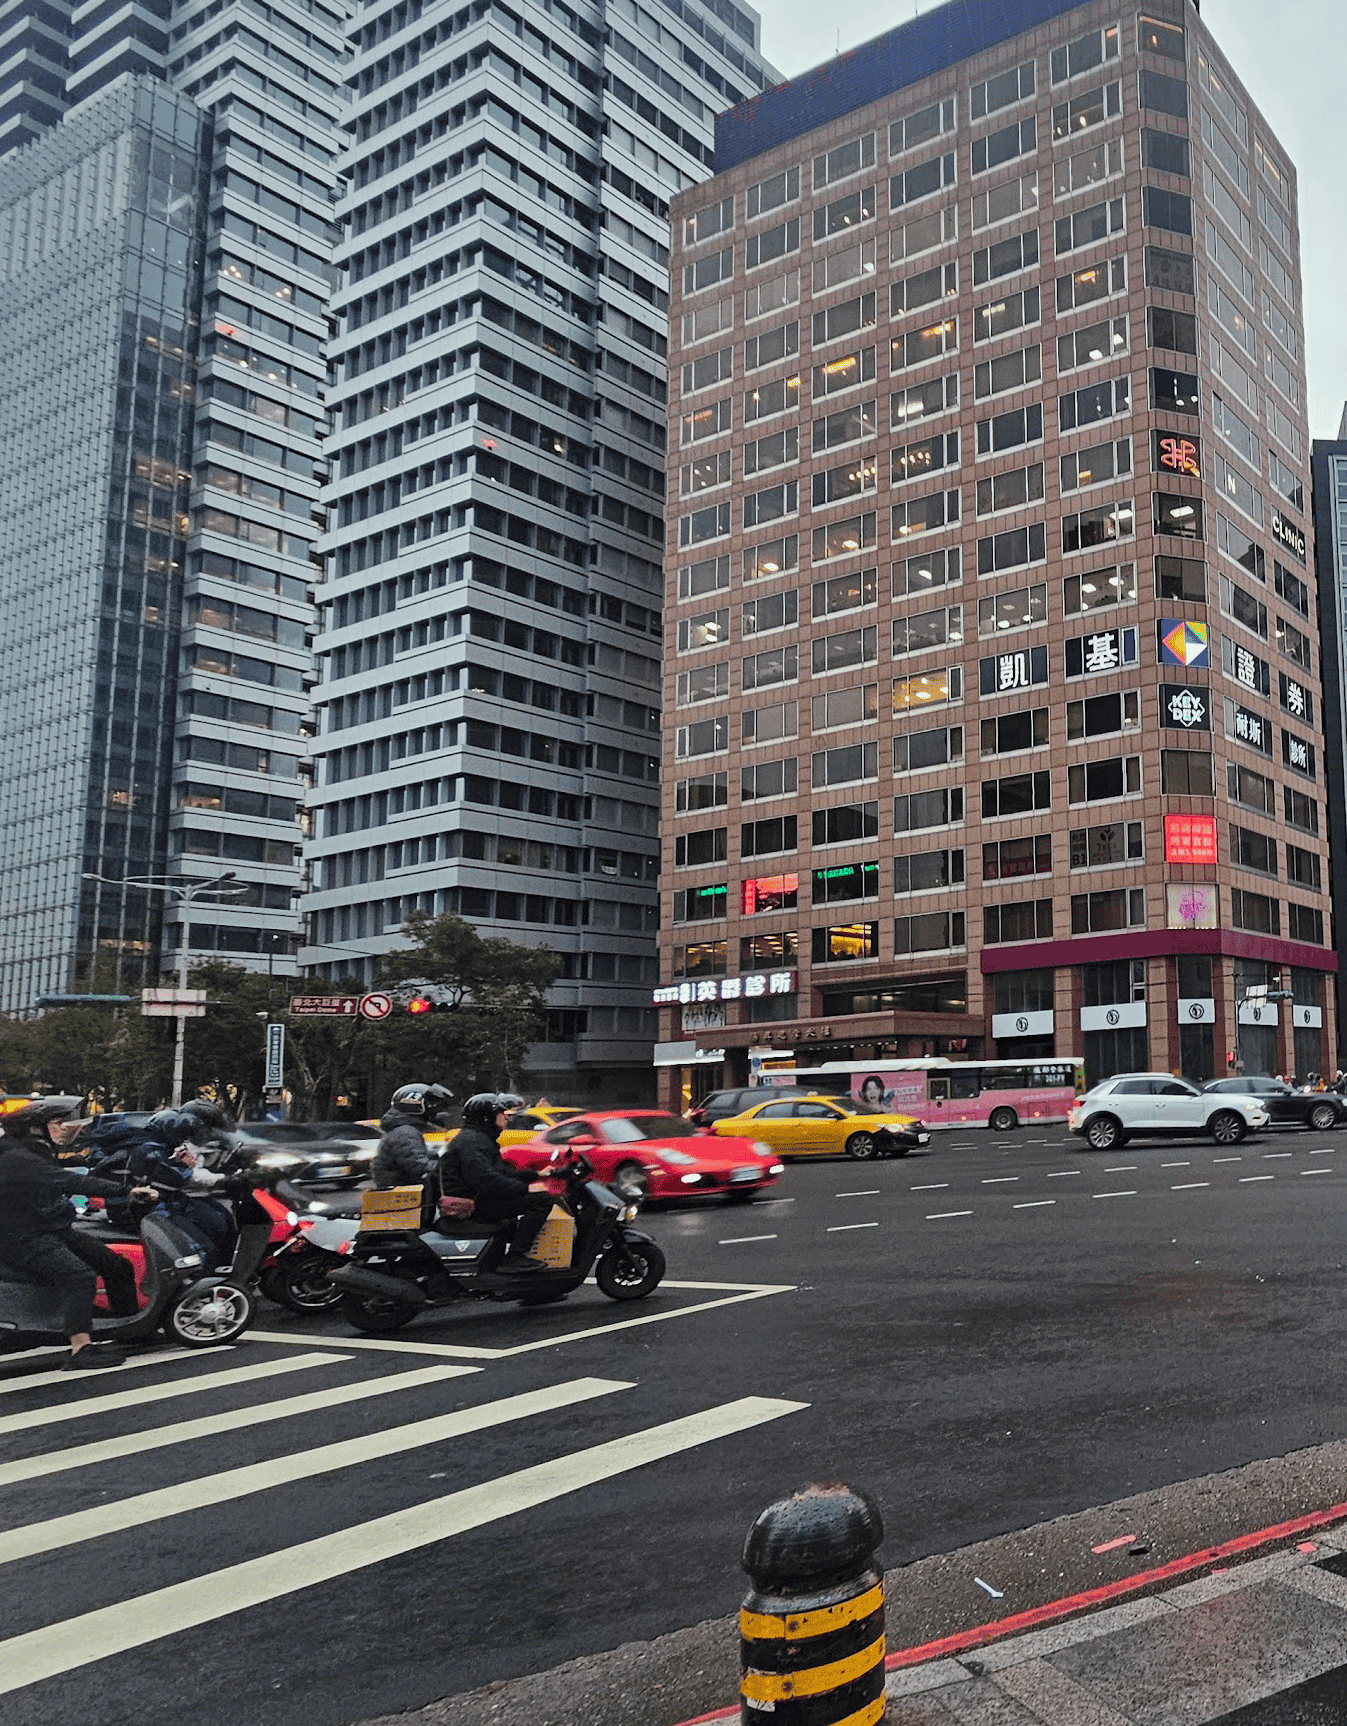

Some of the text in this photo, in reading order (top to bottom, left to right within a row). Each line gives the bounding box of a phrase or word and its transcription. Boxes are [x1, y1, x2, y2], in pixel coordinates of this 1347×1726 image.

[1226, 473, 1305, 555] N CLINIC
[1172, 695, 1201, 709] KEY
[1172, 707, 1202, 722] DEX
